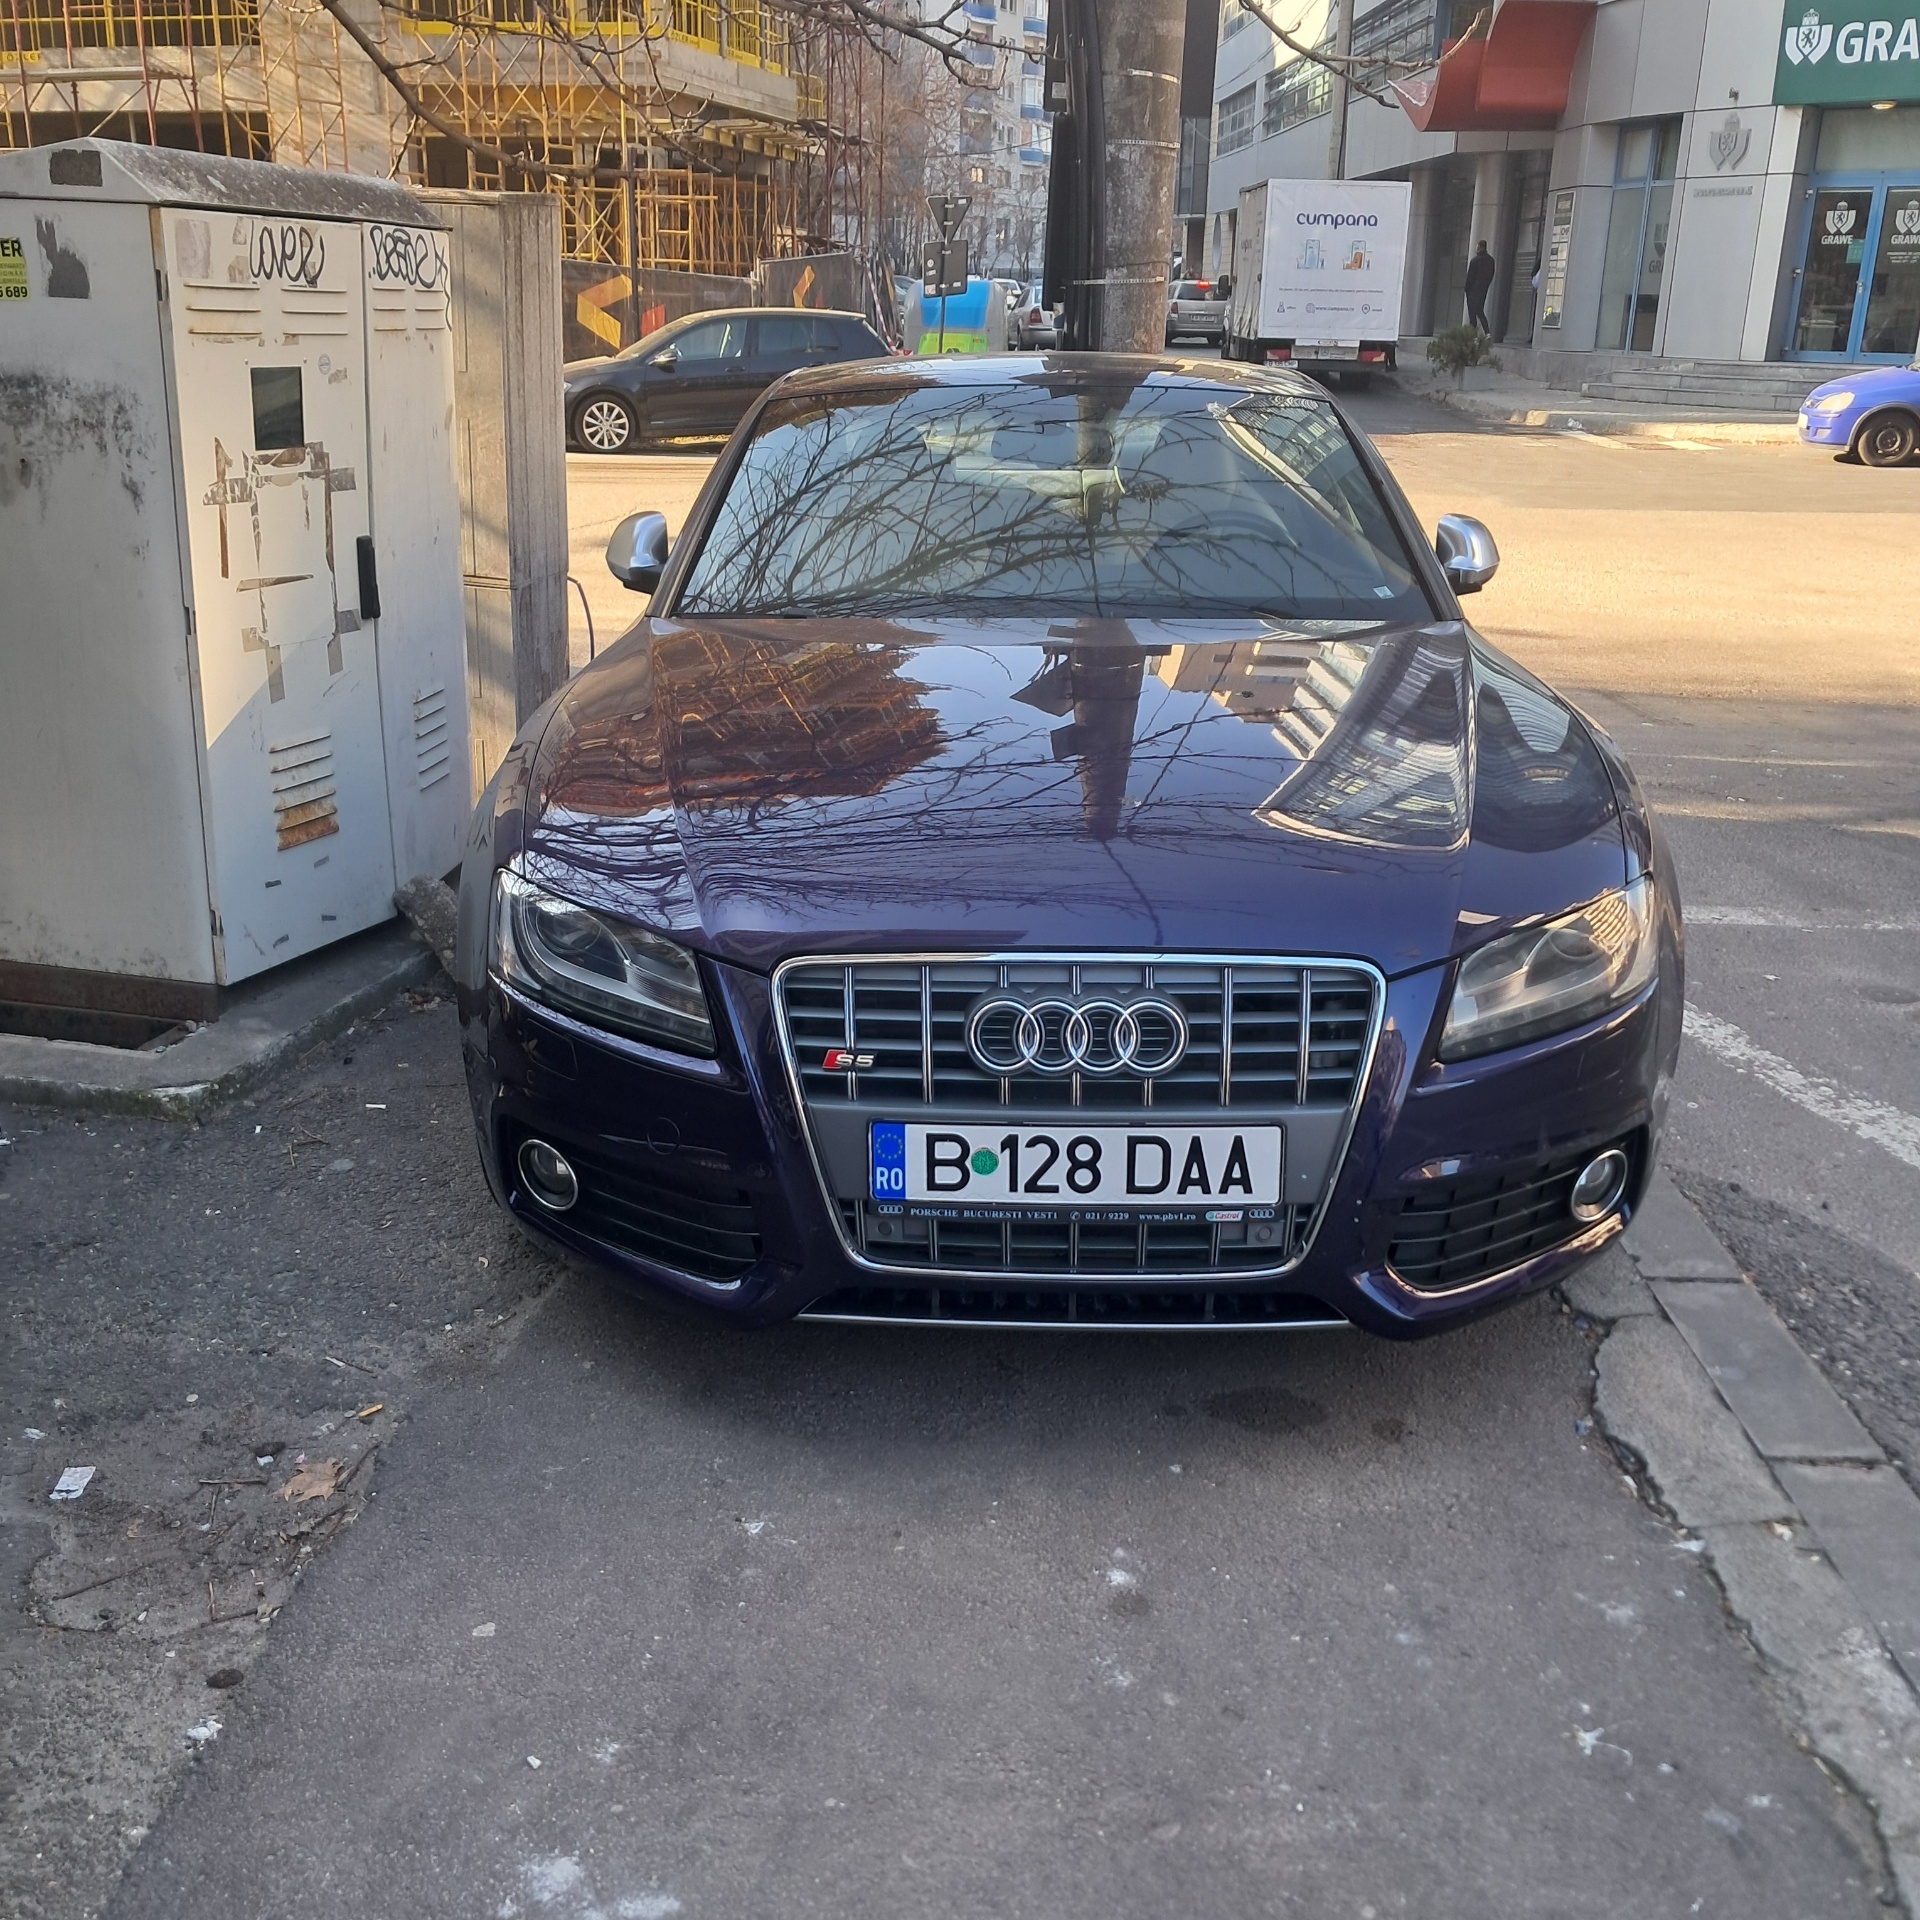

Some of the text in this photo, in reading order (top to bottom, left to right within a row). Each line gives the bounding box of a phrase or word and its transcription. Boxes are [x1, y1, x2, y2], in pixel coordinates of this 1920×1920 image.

[1835, 18, 1920, 64] GRA
[1296, 212, 1378, 229] cumpana
[1821, 235, 1854, 245] GRAWE
[835, 1054, 874, 1067] S5
[926, 1132, 1253, 1195] B 128 DAA
[876, 1167, 903, 1190] RO
[910, 1207, 958, 1217] PORSCHE
[963, 1210, 1022, 1219] BUCURESTI
[1213, 1211, 1241, 1220] Castrol
